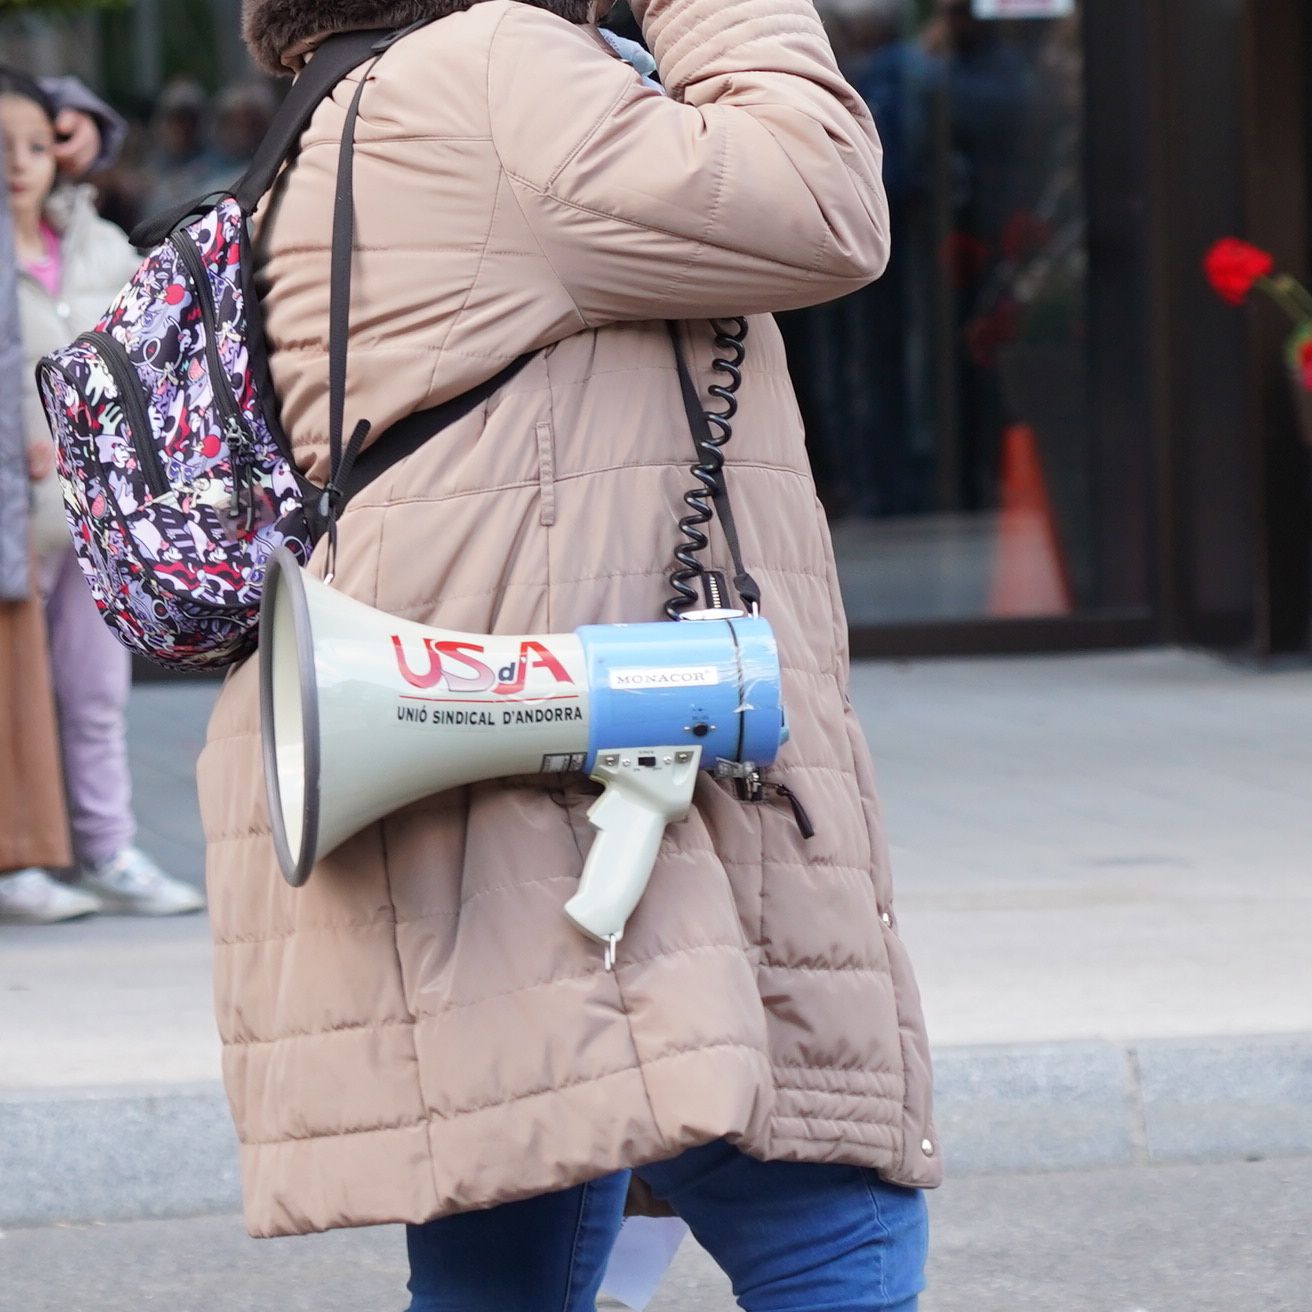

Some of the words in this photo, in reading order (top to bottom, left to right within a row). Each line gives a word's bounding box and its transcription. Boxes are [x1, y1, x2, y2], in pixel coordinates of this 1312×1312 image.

[616, 672, 705, 684] MONACOR
[397, 705, 427, 723] UNIÓ
[432, 710, 495, 725] SINDICAL
[503, 706, 583, 725] D'ANDORRA
